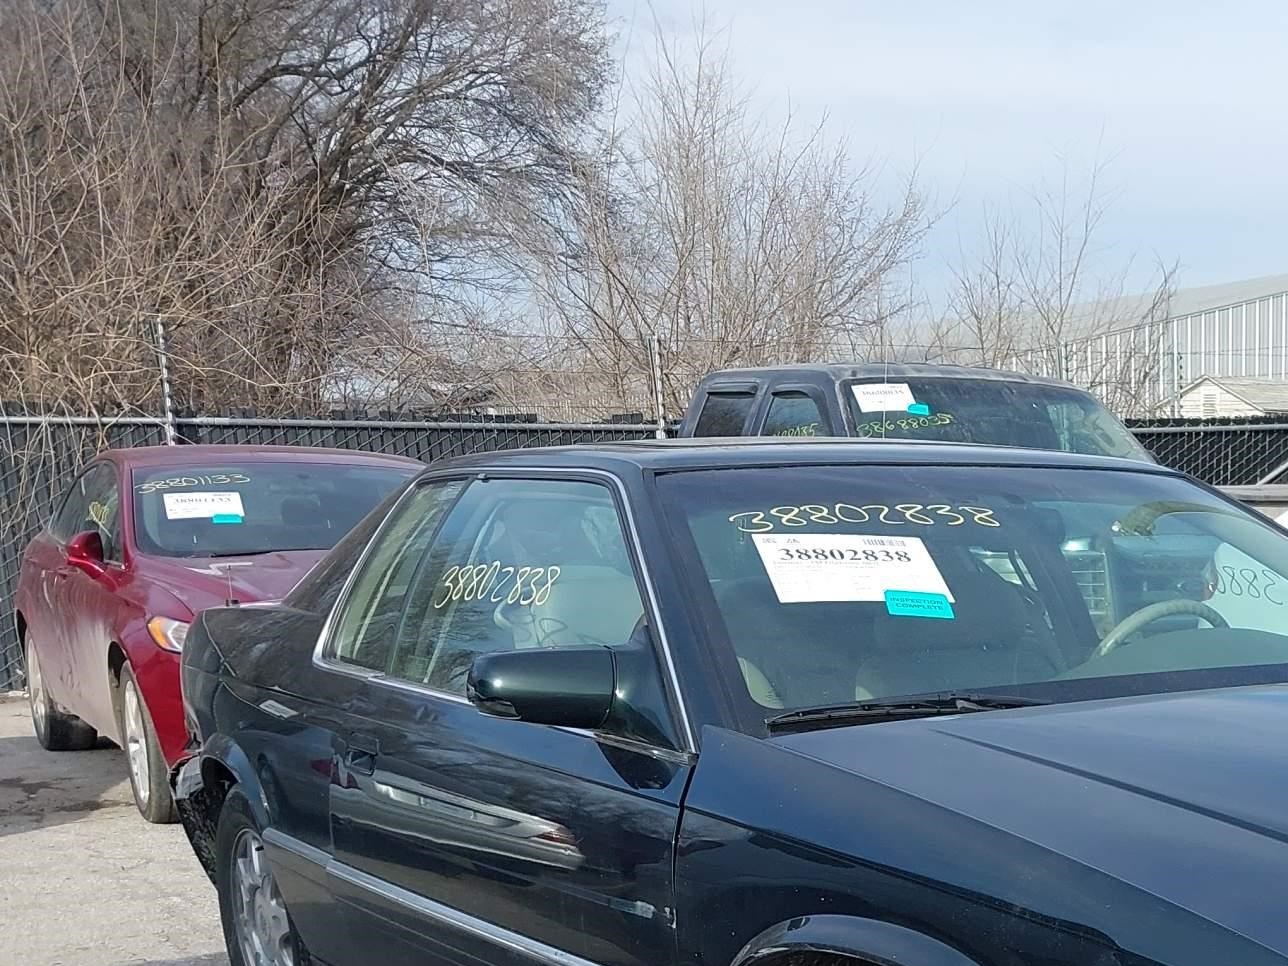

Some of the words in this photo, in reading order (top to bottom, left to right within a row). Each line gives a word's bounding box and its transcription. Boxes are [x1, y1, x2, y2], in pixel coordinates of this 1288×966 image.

[135, 474, 250, 494] 38801133
[728, 503, 1001, 533] 38802838
[778, 547, 912, 563] 38802838
[434, 560, 561, 609] 38802838
